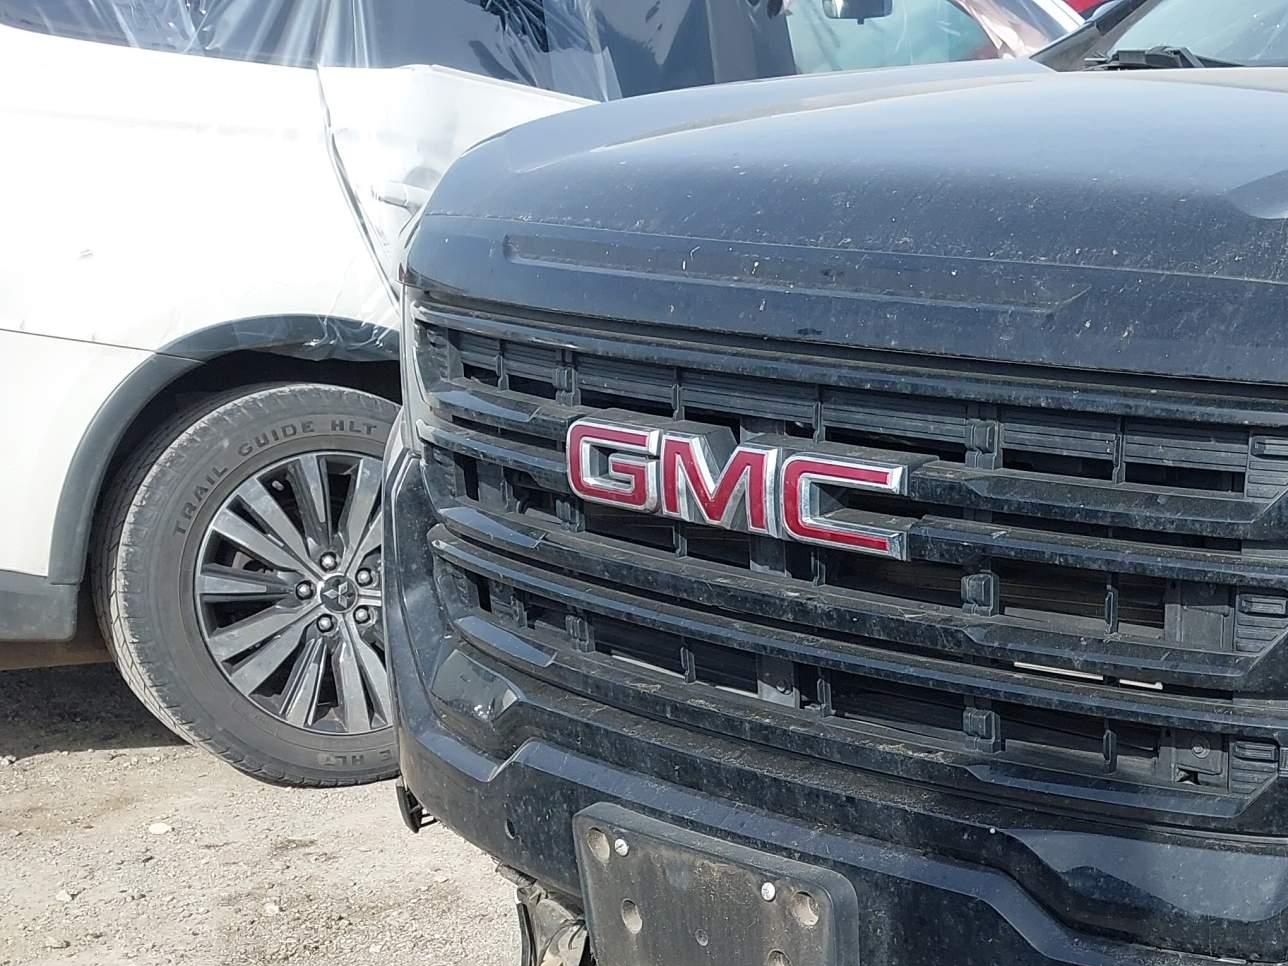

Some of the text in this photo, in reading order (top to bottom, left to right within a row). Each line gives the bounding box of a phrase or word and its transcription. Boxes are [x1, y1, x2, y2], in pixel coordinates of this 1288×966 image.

[173, 419, 377, 537] TRAIL GUIDE HLT
[565, 415, 910, 562] GMC
